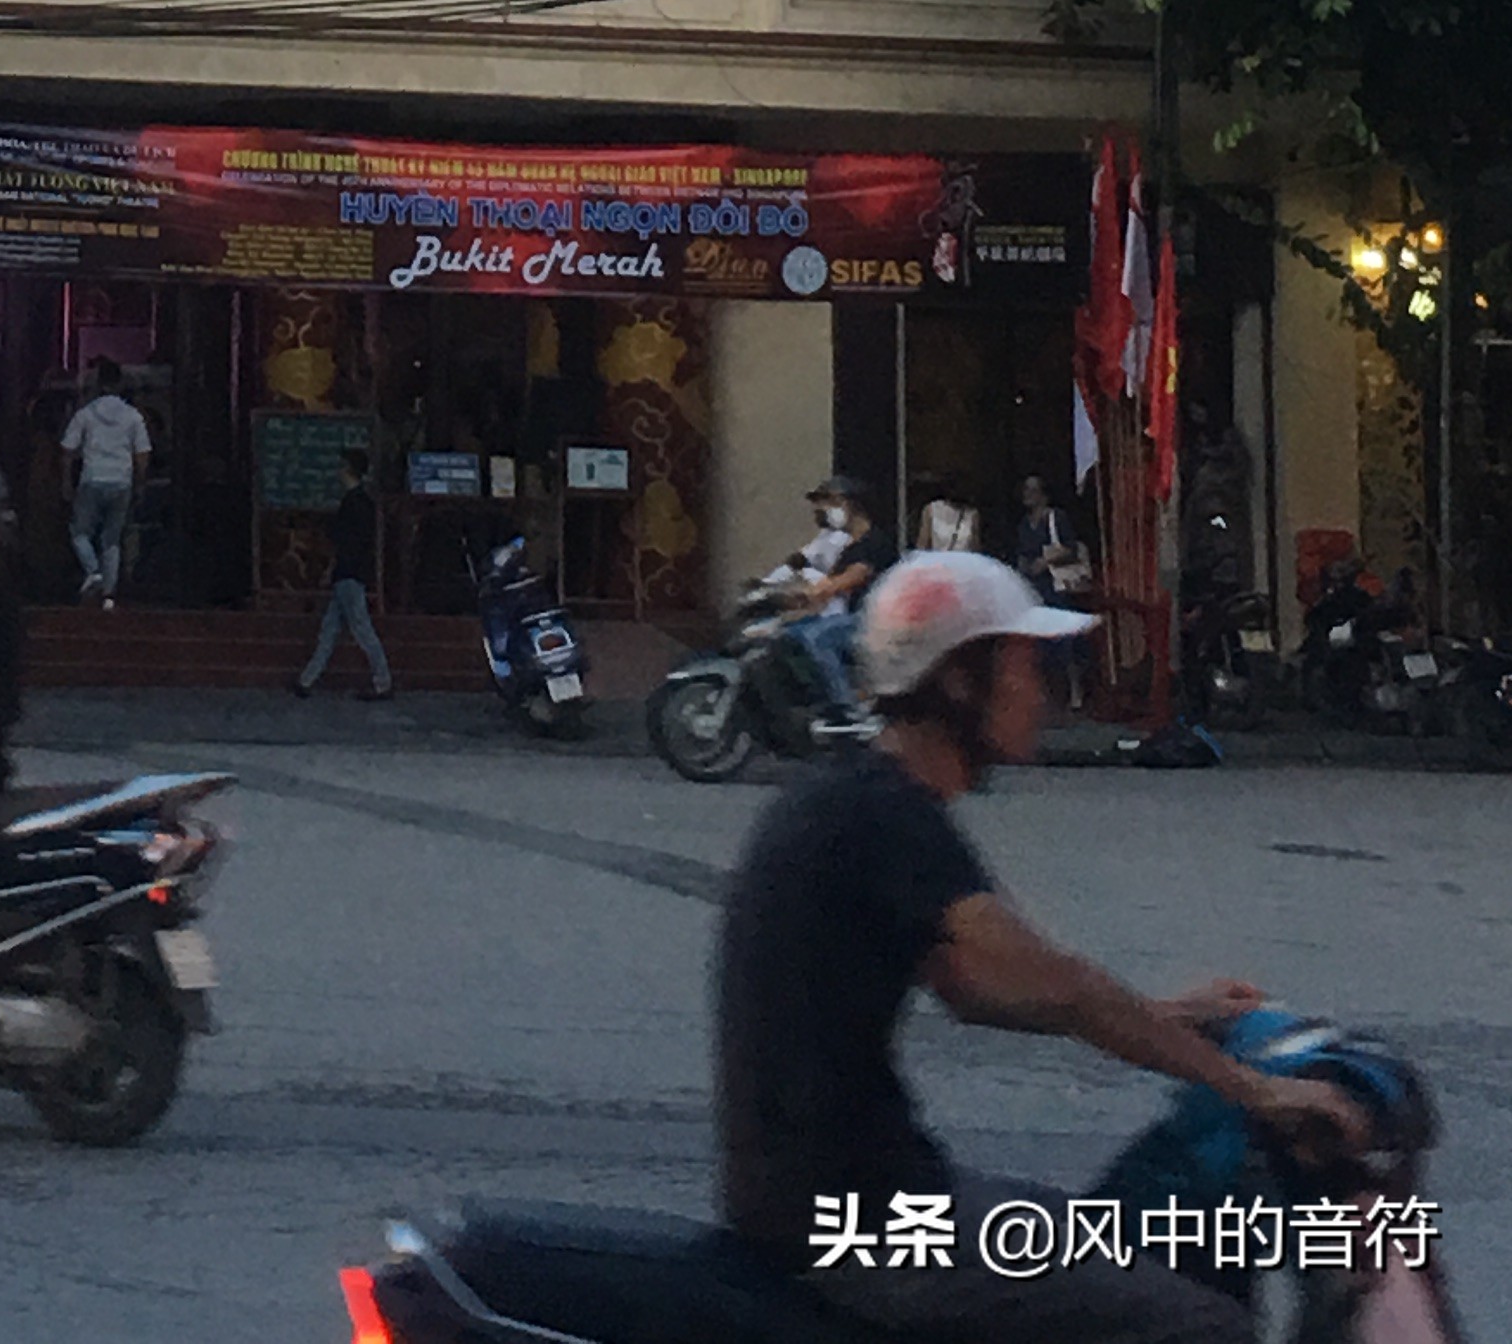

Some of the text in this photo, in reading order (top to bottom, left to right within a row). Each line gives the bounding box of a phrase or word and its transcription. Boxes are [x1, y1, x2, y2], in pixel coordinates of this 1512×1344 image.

[467, 197, 573, 237] THOẠI
[581, 199, 681, 240] NGỌN
[389, 235, 515, 288] Bukit
[521, 238, 665, 284] Merah
[831, 259, 922, 286] SIFAS
